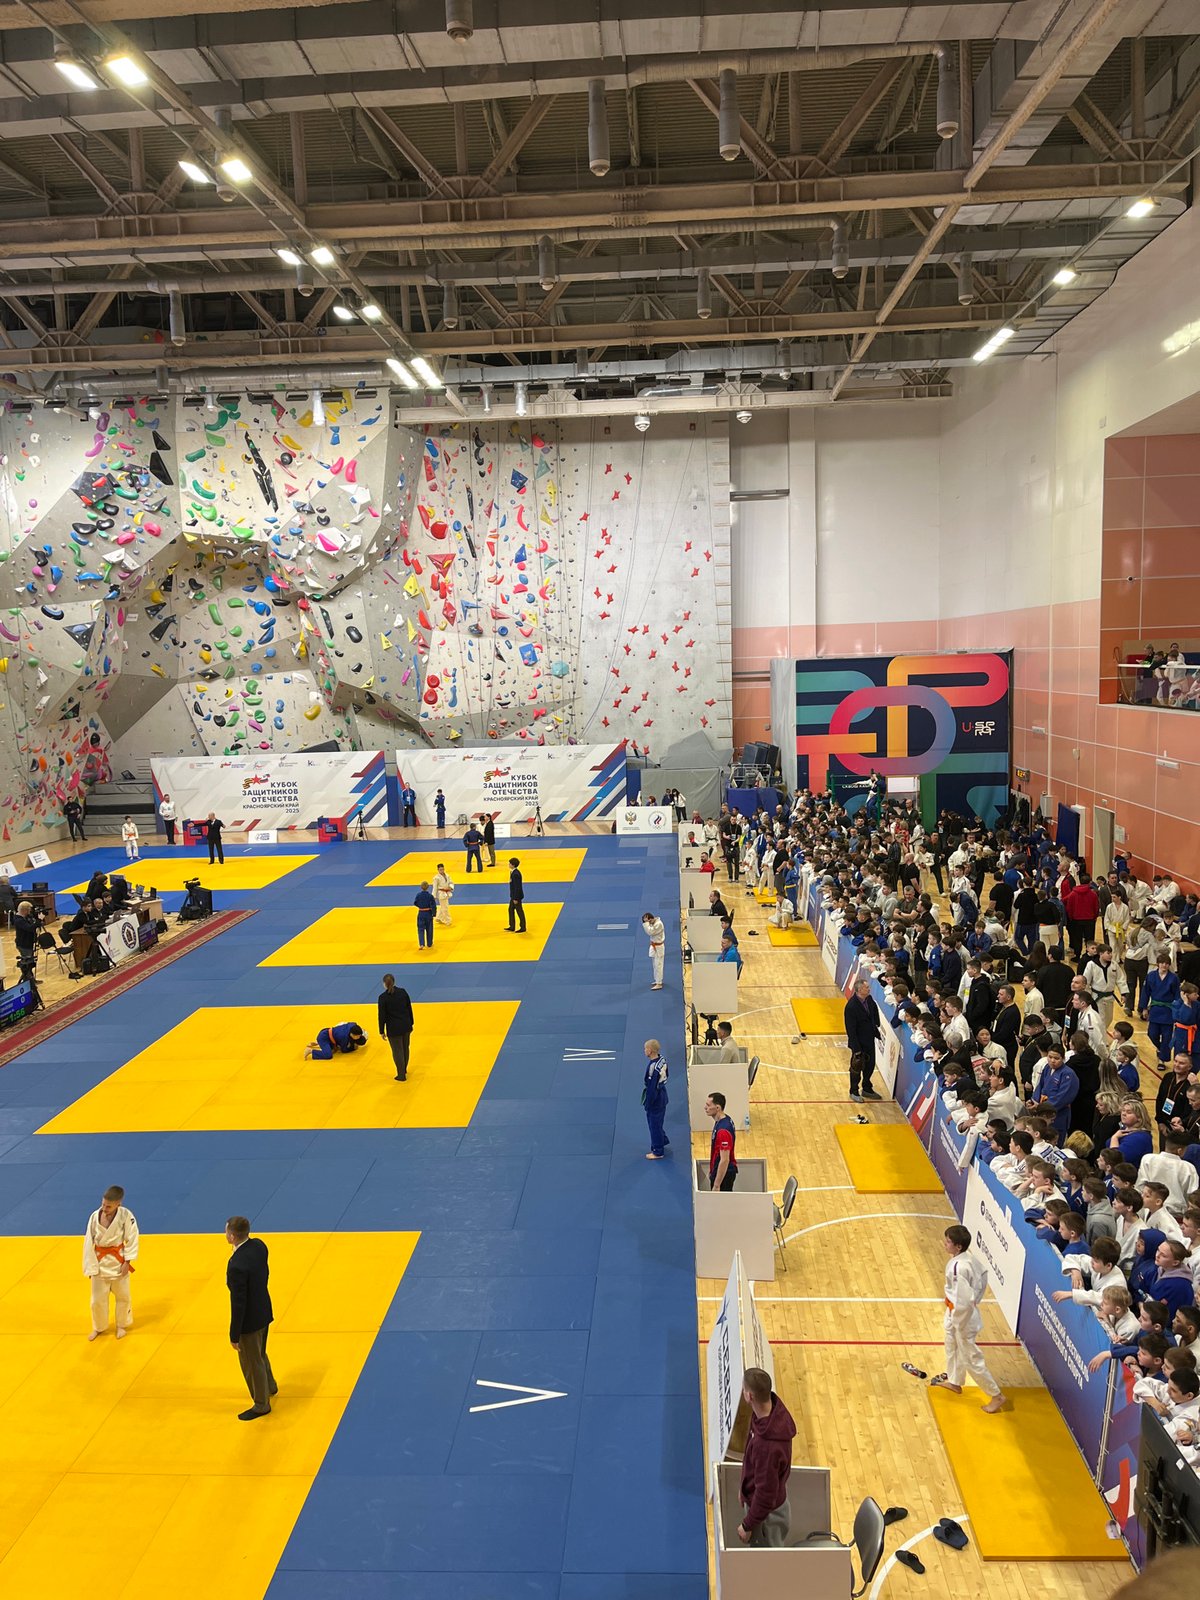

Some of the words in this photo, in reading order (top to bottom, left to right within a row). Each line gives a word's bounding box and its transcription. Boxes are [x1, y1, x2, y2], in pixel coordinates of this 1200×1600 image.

[483, 781, 538, 789] ЗАЩИТНИКОВ
[242, 788, 299, 797] ЗАЩИТНИКОВ
[492, 788, 538, 796] ОТЕЧЕСТВА
[1035, 1282, 1067, 1342] ВСЕРОССИЙСКИЙ
[1065, 1335, 1090, 1383] ФЕСТИВАЛЬ
